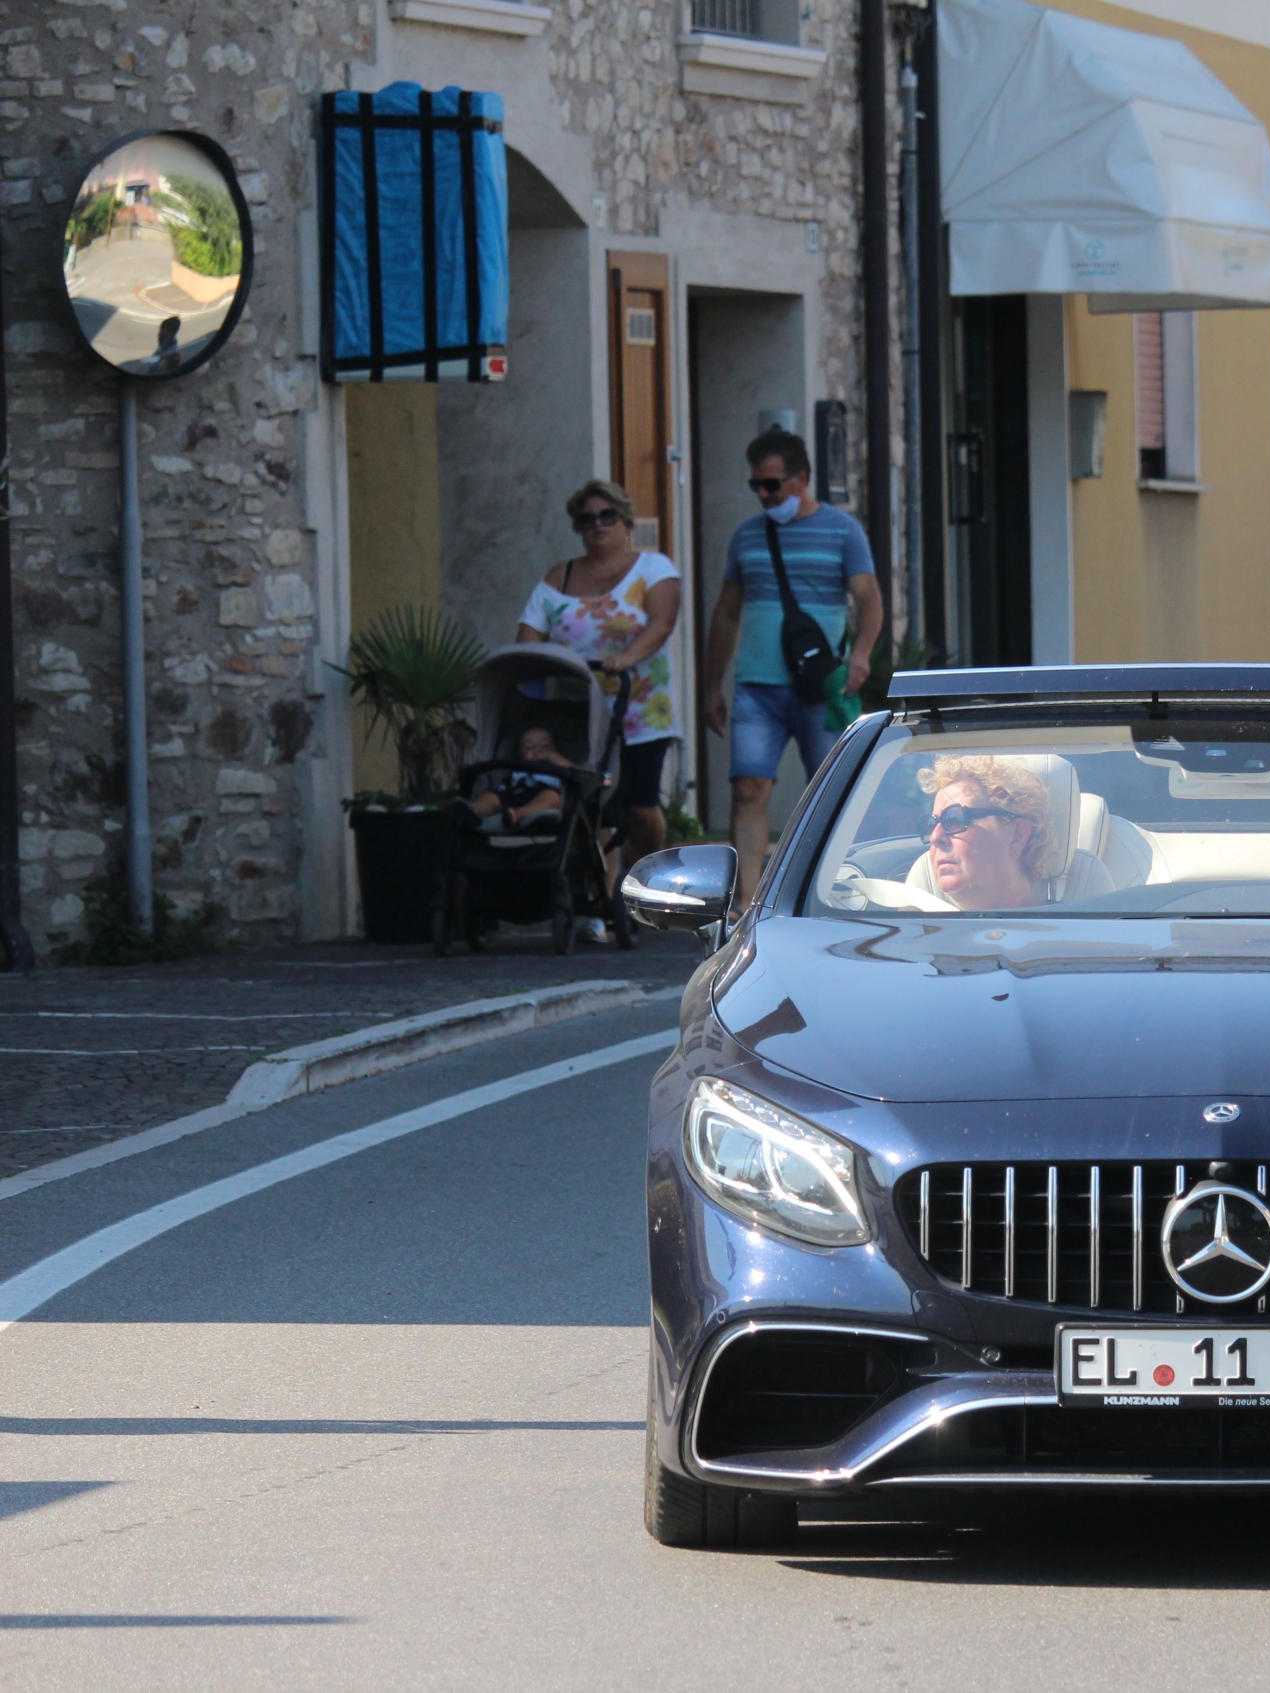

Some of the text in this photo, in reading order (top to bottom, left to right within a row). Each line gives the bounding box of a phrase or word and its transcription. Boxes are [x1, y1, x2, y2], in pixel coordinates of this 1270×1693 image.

[1070, 1337, 1137, 1387] EL
[1192, 1337, 1256, 1387] 11
[1104, 1396, 1180, 1406] KUNZMANN
[1218, 1397, 1233, 1406] Die
[1235, 1398, 1257, 1406] neue
